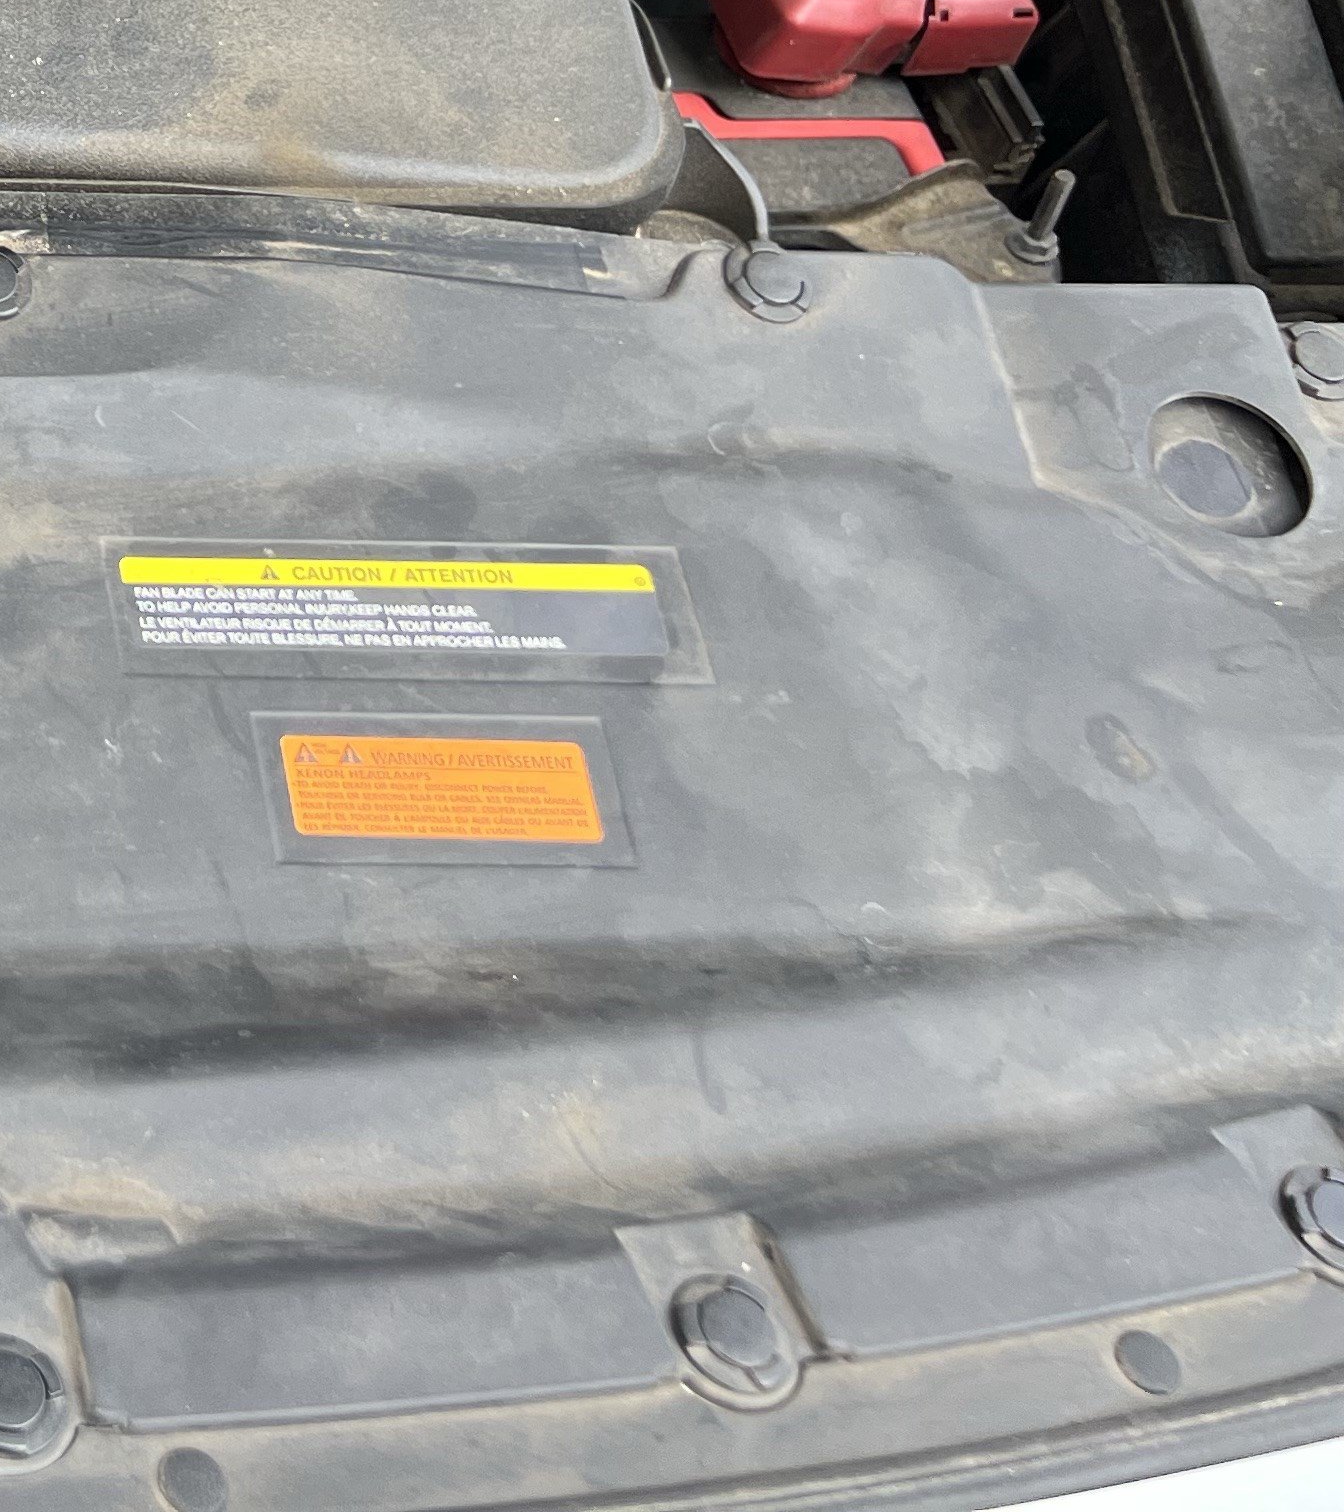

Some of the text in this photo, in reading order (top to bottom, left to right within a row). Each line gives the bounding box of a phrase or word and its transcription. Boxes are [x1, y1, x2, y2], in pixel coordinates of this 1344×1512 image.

[292, 566, 513, 585] CAUTION / ATTENTION
[134, 587, 160, 599] FAN
[162, 587, 203, 600] BLADE
[206, 588, 234, 600] CAN
[236, 589, 276, 600] START
[278, 589, 294, 600] AT
[296, 589, 323, 601] ANY
[137, 601, 156, 613] TO
[158, 601, 191, 613] HELP
[193, 602, 232, 614] AVOID
[233, 602, 305, 615] PERSONAL
[384, 604, 430, 617] HANDS
[139, 616, 158, 629] LE
[160, 616, 242, 630] VENTILATEUR
[243, 617, 293, 631] RISQUE
[294, 618, 312, 631] DE
[398, 620, 432, 633] TOUT
[142, 631, 181, 644] POUR
[227, 633, 271, 645] TOUTE
[344, 634, 364, 646] NE
[364, 634, 392, 647] PAS
[393, 635, 412, 647] EN
[413, 635, 494, 649] APPROCHER
[495, 636, 520, 649] LES
[371, 751, 446, 767] WARNING
[457, 753, 574, 770] AVERTISSEMENT
[296, 768, 344, 779] XENON
